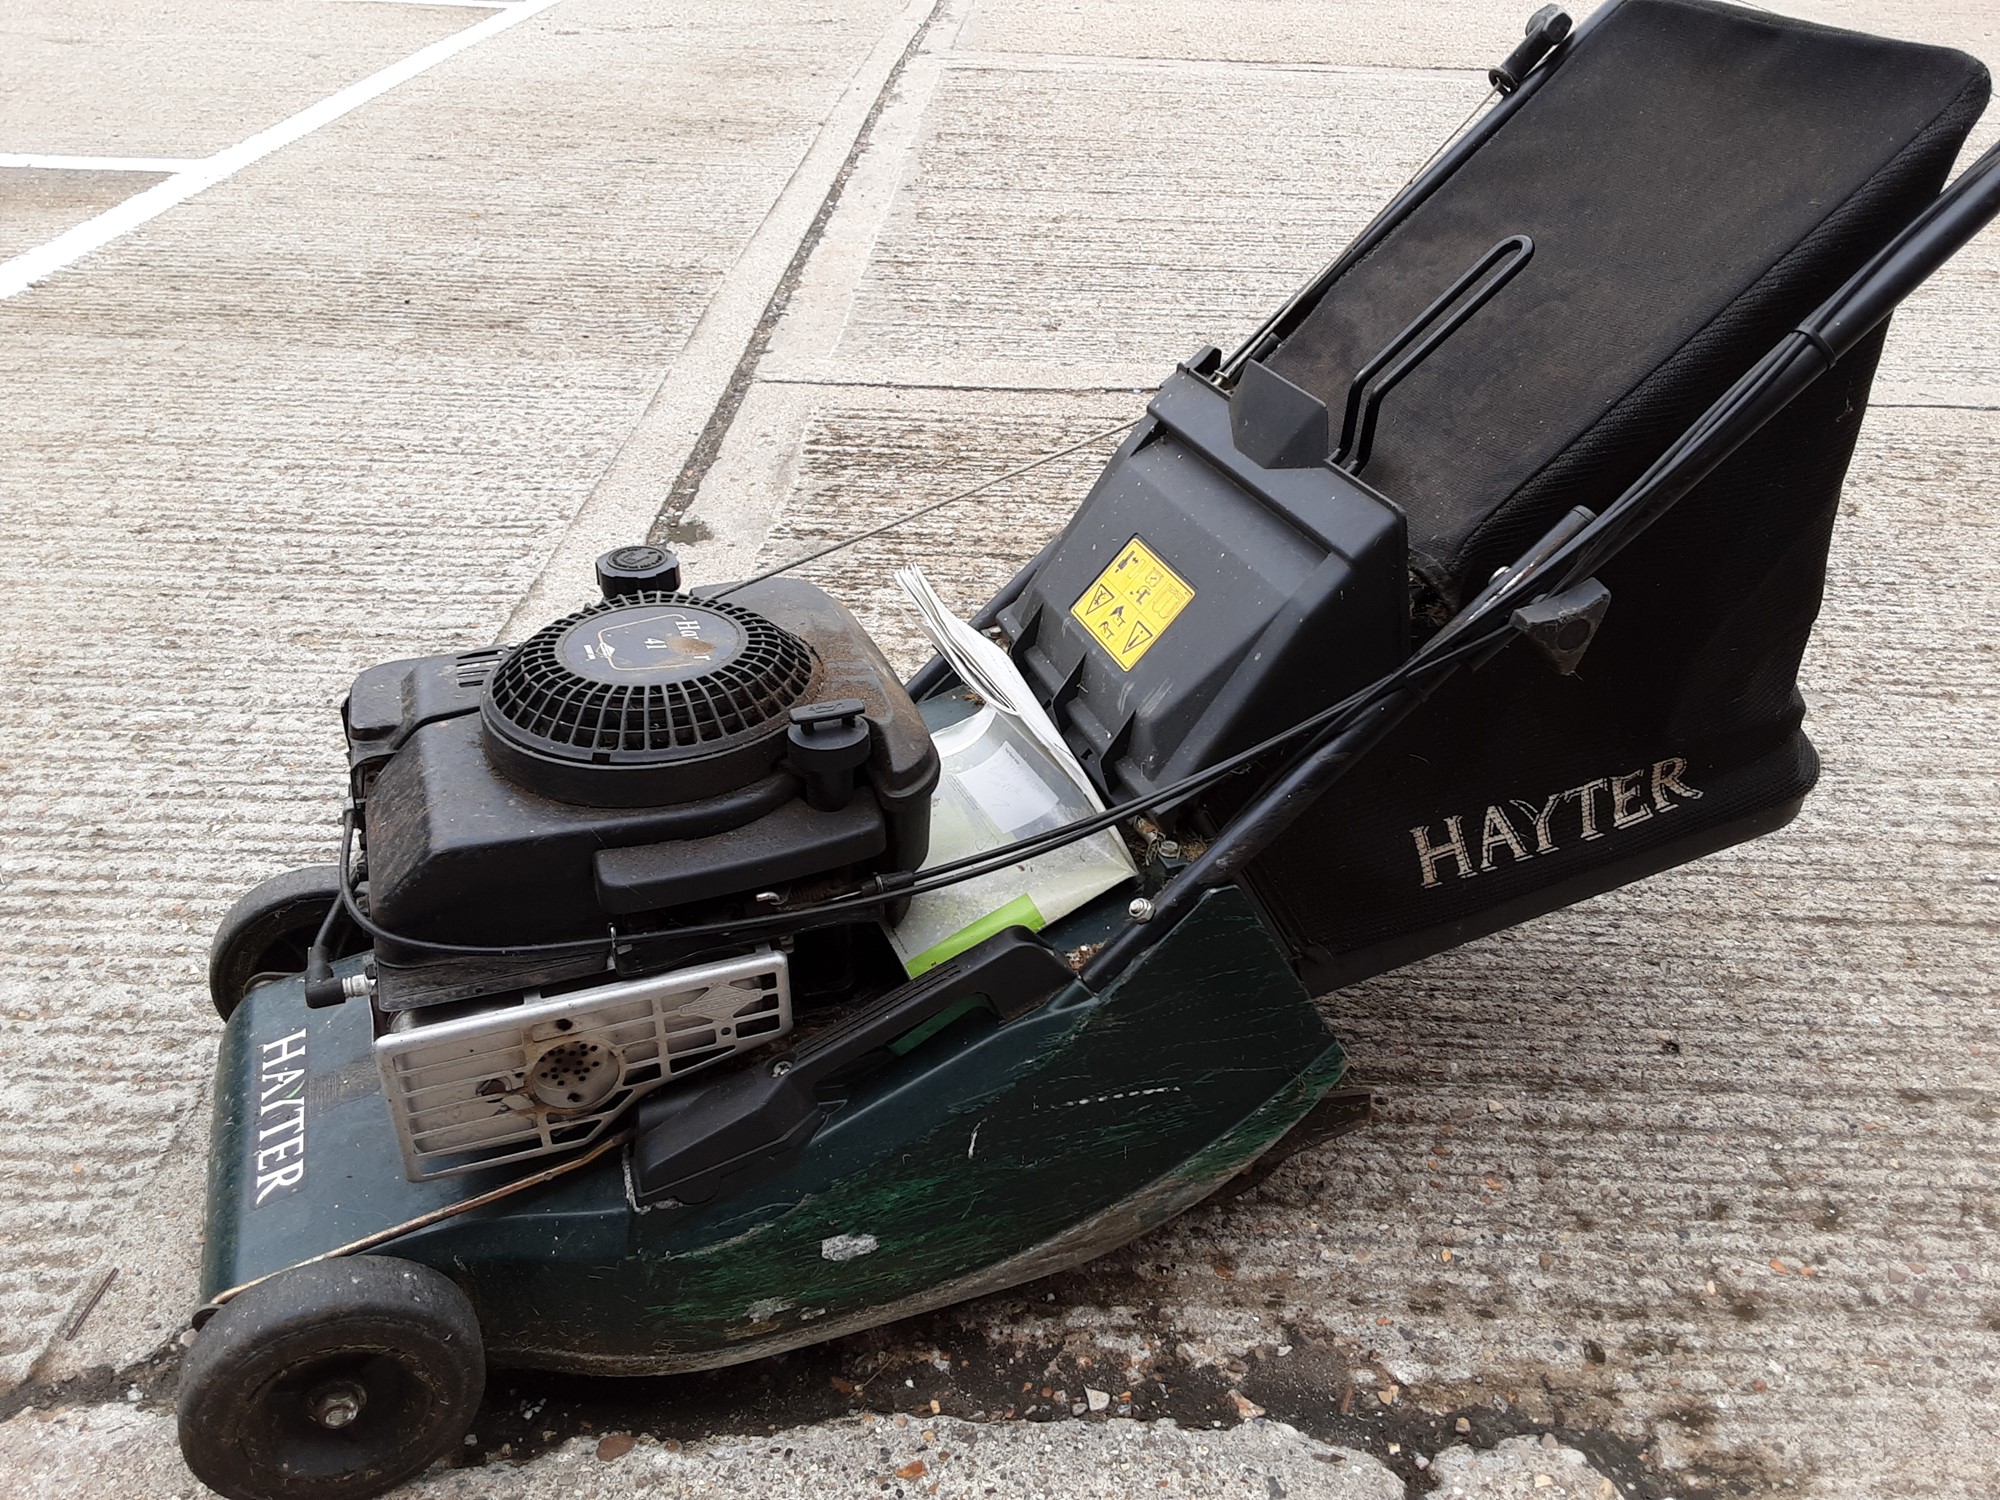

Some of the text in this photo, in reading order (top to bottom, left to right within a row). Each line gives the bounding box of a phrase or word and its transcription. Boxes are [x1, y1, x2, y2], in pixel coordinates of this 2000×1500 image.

[644, 638, 667, 649] 41
[1409, 757, 1704, 888] HAYTER
[256, 1028, 307, 1205] HAYTER
